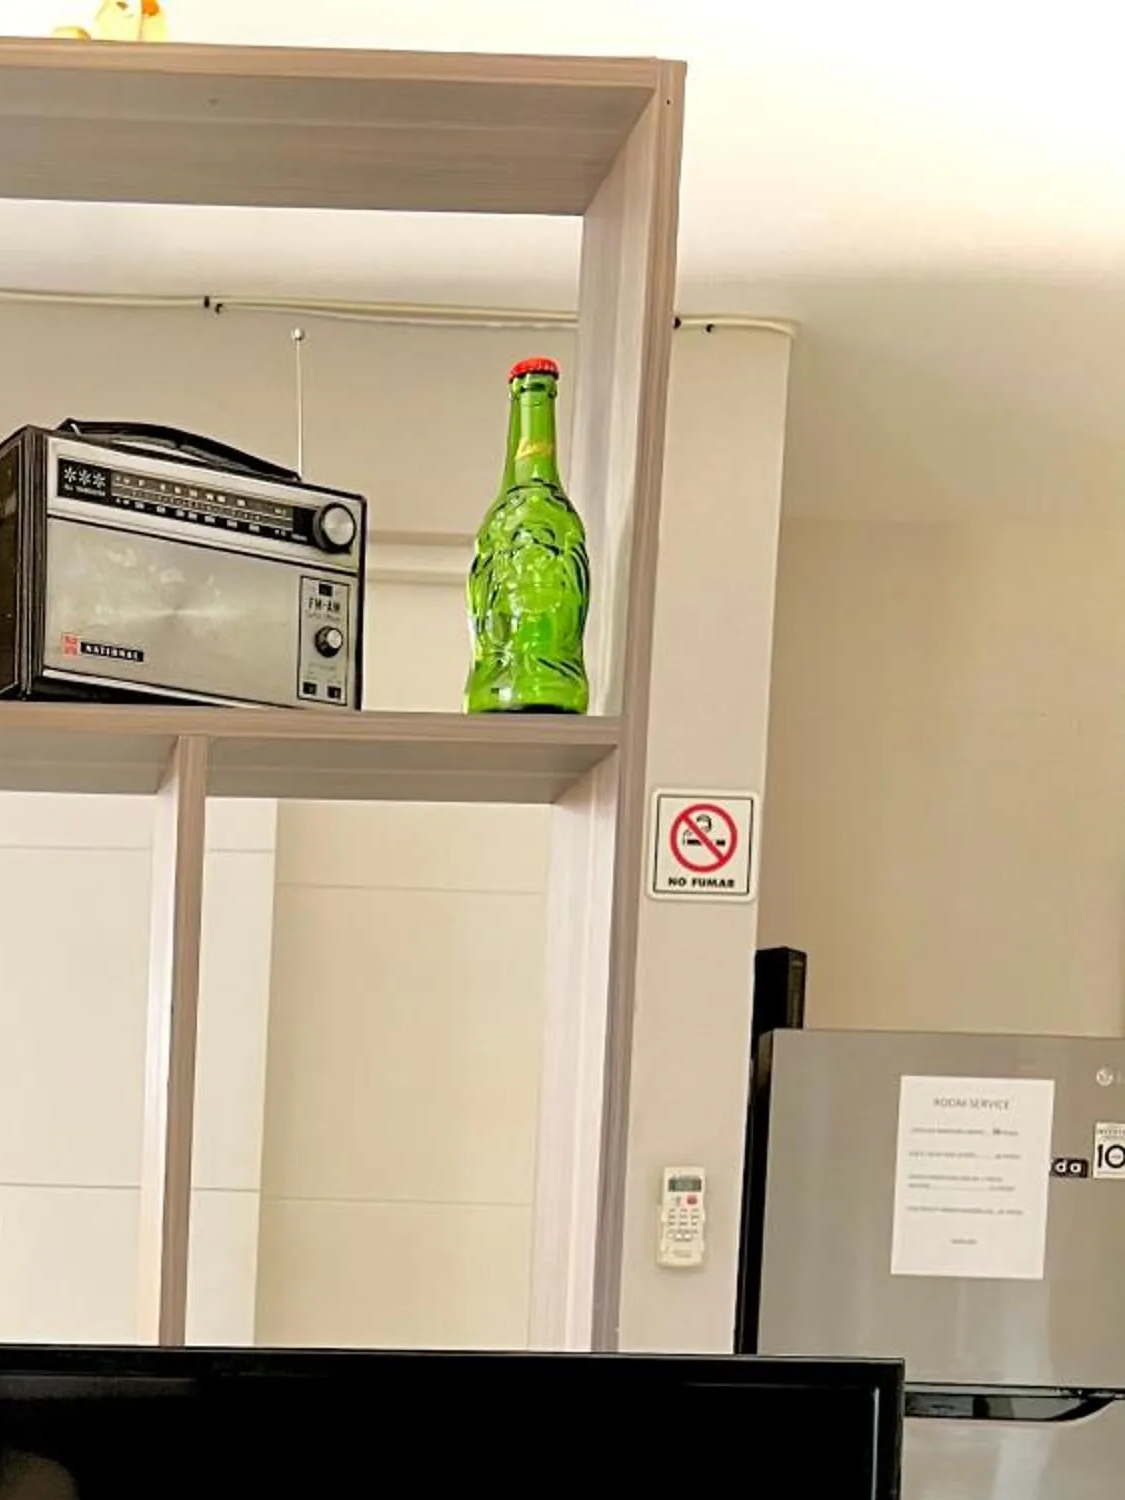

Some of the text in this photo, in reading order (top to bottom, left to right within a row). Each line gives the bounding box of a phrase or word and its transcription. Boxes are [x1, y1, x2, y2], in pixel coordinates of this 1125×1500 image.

[668, 877, 735, 888] NO FUMAR
[933, 1098, 1010, 1111] ROOM SERVICE
